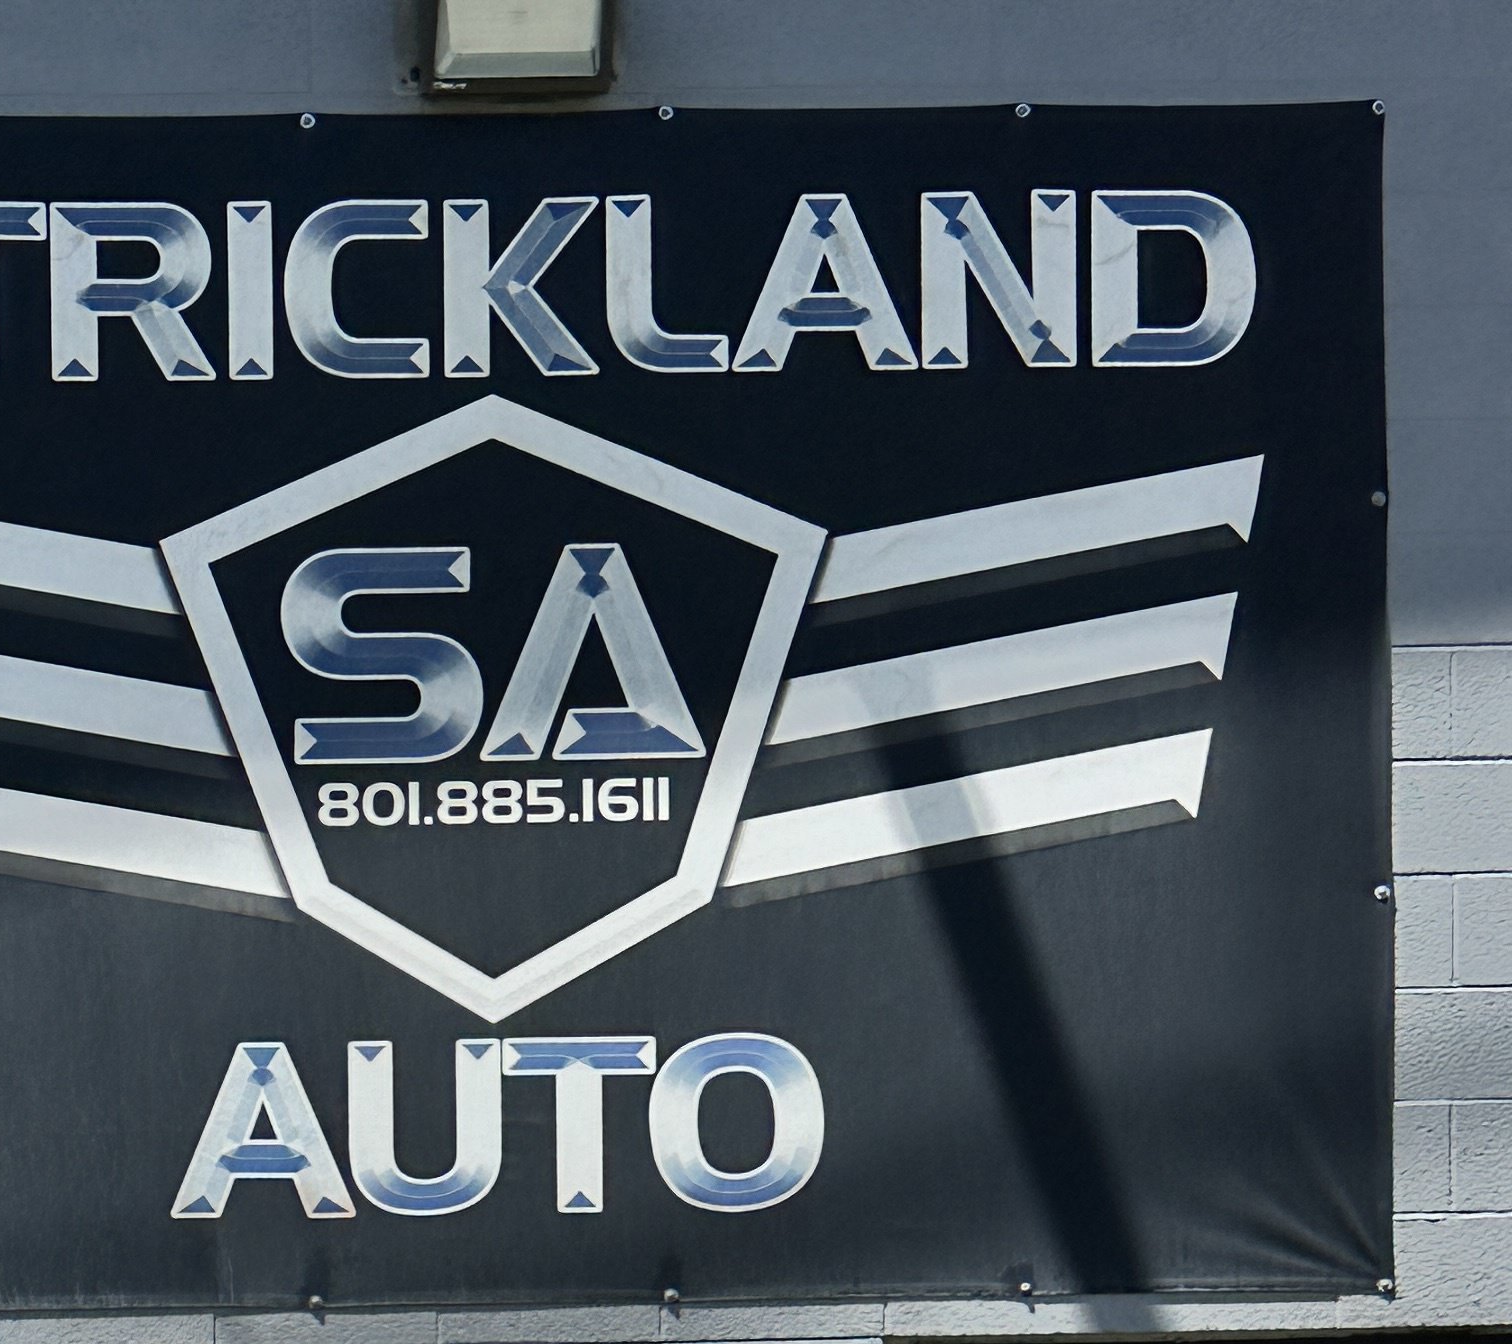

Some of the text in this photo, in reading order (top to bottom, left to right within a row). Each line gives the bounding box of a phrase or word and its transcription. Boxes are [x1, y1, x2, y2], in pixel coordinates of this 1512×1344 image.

[279, 542, 707, 766] SA
[317, 776, 670, 827] 801.885.1611
[169, 1031, 826, 1220] AUTO
